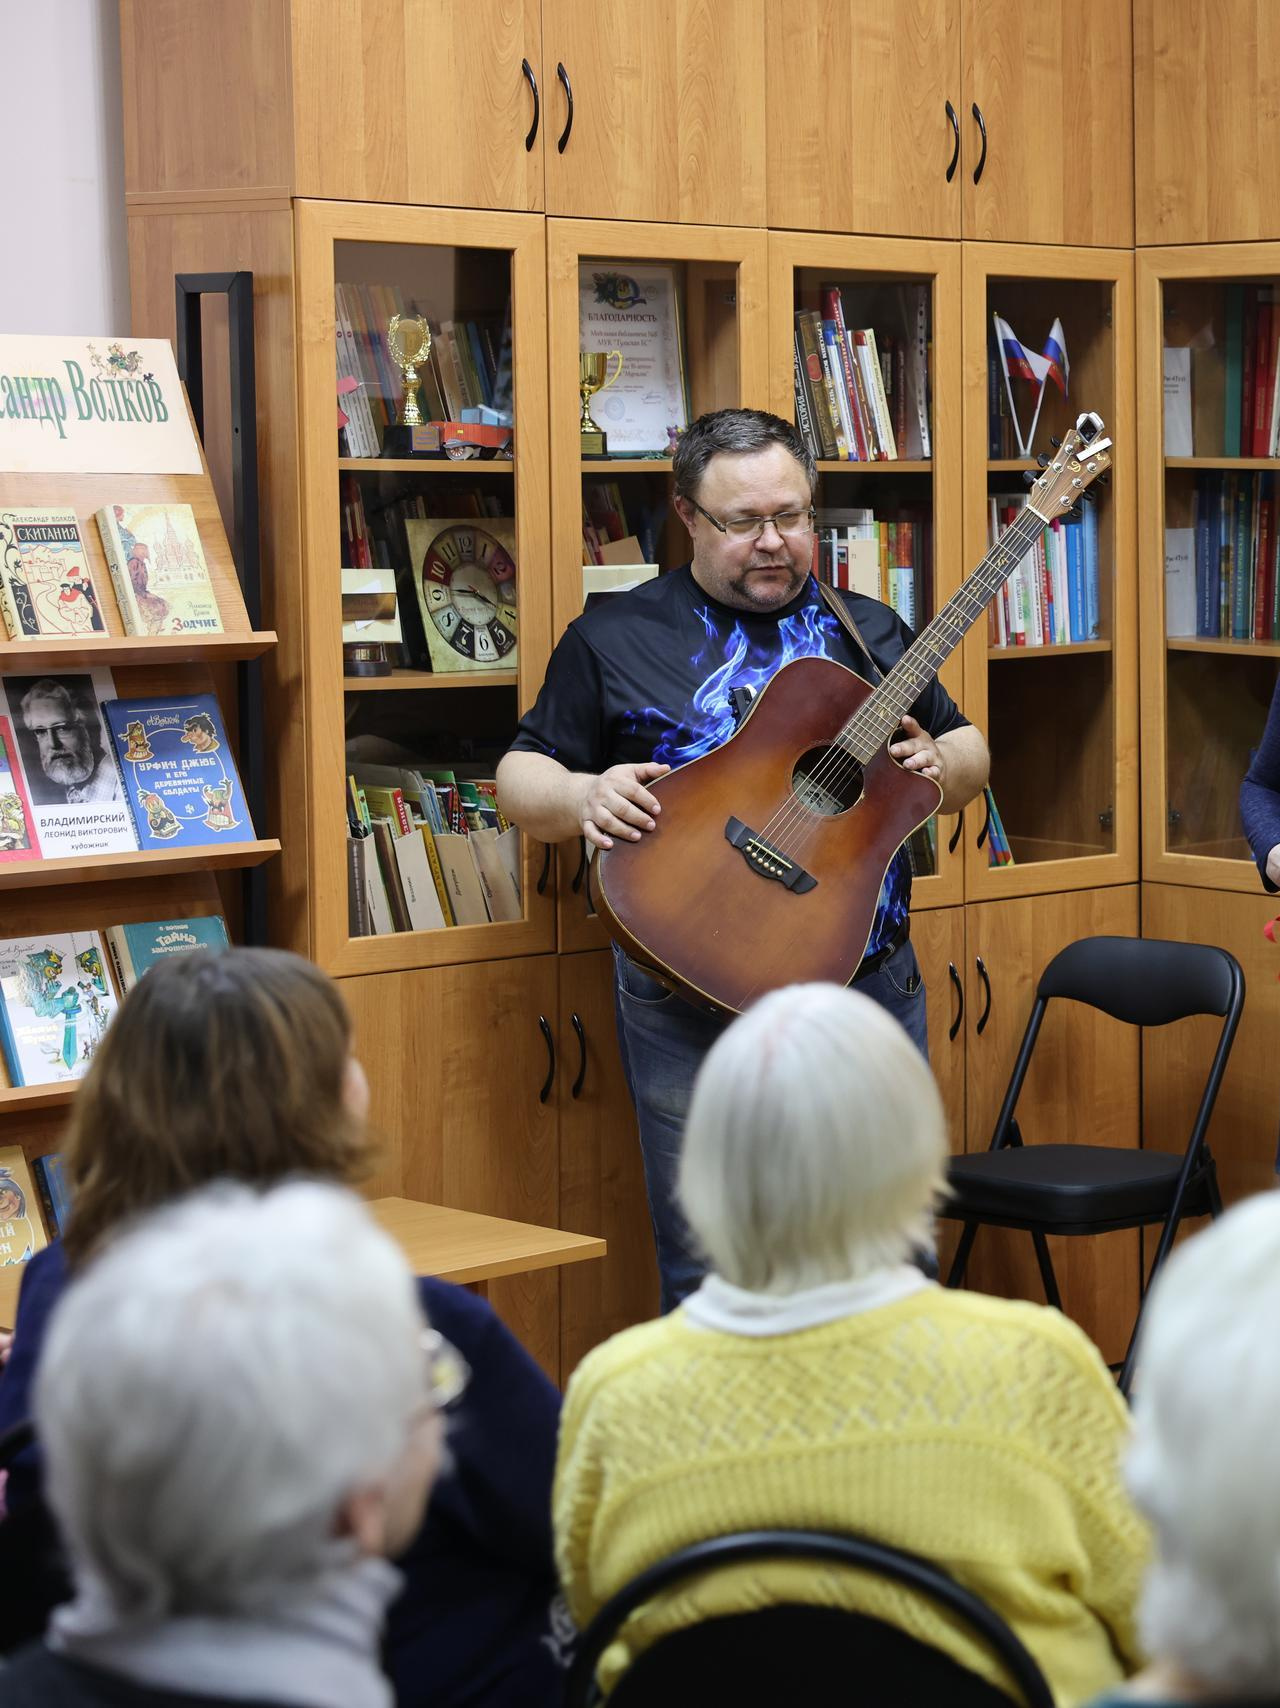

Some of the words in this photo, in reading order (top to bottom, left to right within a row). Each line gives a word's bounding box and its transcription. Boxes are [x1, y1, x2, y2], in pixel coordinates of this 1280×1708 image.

[588, 313, 658, 322] БЛАГОДАРНОСТЬ
[62, 360, 169, 424] Волков
[796, 395, 810, 432] ИСТОРИЯ
[17, 527, 79, 541] СКИТАНИЯ
[431, 560, 446, 579] 10
[441, 612, 455, 628] 8
[461, 626, 471, 646] 7
[479, 631, 489, 651] 6
[494, 626, 507, 646] 5
[139, 761, 178, 771] УРФИН
[181, 758, 216, 771] ДЖЮС
[155, 778, 205, 789] ДЕРЕВЯННЫЕ
[163, 787, 200, 796] СОЛДАТЫ
[40, 812, 126, 827] ВЛАДИМИРСКИЙ
[44, 830, 77, 838] ЛЕОНИД
[78, 827, 128, 836] ВИКТОРОВИЧ
[71, 842, 109, 850] художник
